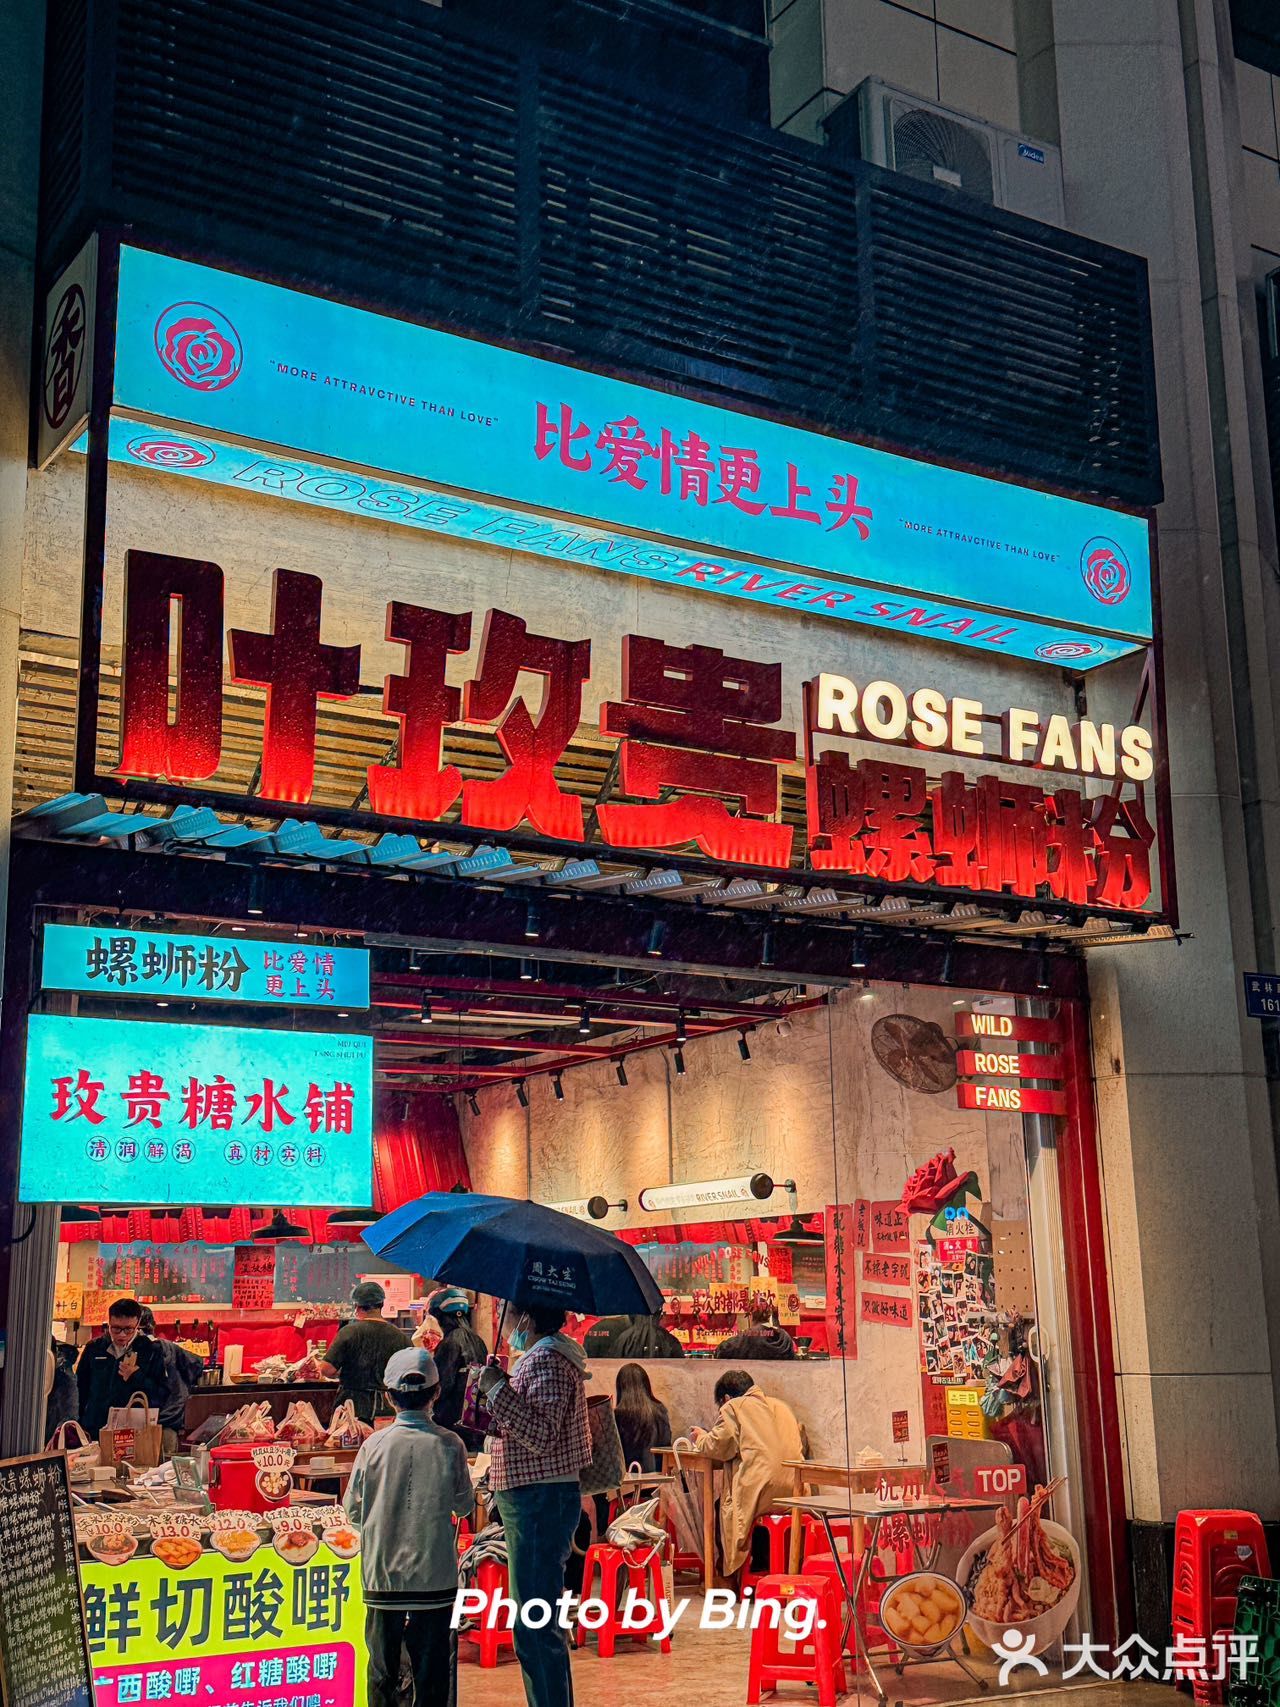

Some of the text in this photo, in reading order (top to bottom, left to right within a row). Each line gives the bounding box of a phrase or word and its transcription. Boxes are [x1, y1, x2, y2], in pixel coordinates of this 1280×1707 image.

[324, 375, 416, 407] ATTRAVCTIVE
[421, 400, 455, 417] THAN
[533, 401, 875, 541] 比爱情更上头
[233, 460, 679, 571] ROSE FANS
[1005, 543, 1030, 557] THAN
[673, 561, 1018, 645] RIVER SNAIL
[110, 548, 798, 869] 叶玫贵
[816, 671, 1155, 781] ROSE FANS
[807, 749, 1155, 910] 螺蛳粉
[86, 936, 250, 992] 螺蛳粉
[263, 950, 337, 977] 比爱情
[264, 975, 336, 1001] 更上头
[970, 1014, 1013, 1037] WILD
[974, 1053, 1020, 1074] ROSE
[50, 1068, 356, 1135] 玫贵糖水铺
[975, 1086, 1021, 1109] FANS
[88, 1139, 323, 1163] 清润解渴 真材实料
[717, 1188, 741, 1199] SNAIL
[977, 1468, 1021, 1493] TOP
[265, 1507, 314, 1522] 红糖豆花
[83, 1563, 351, 1655] 鲜切酸嘢
